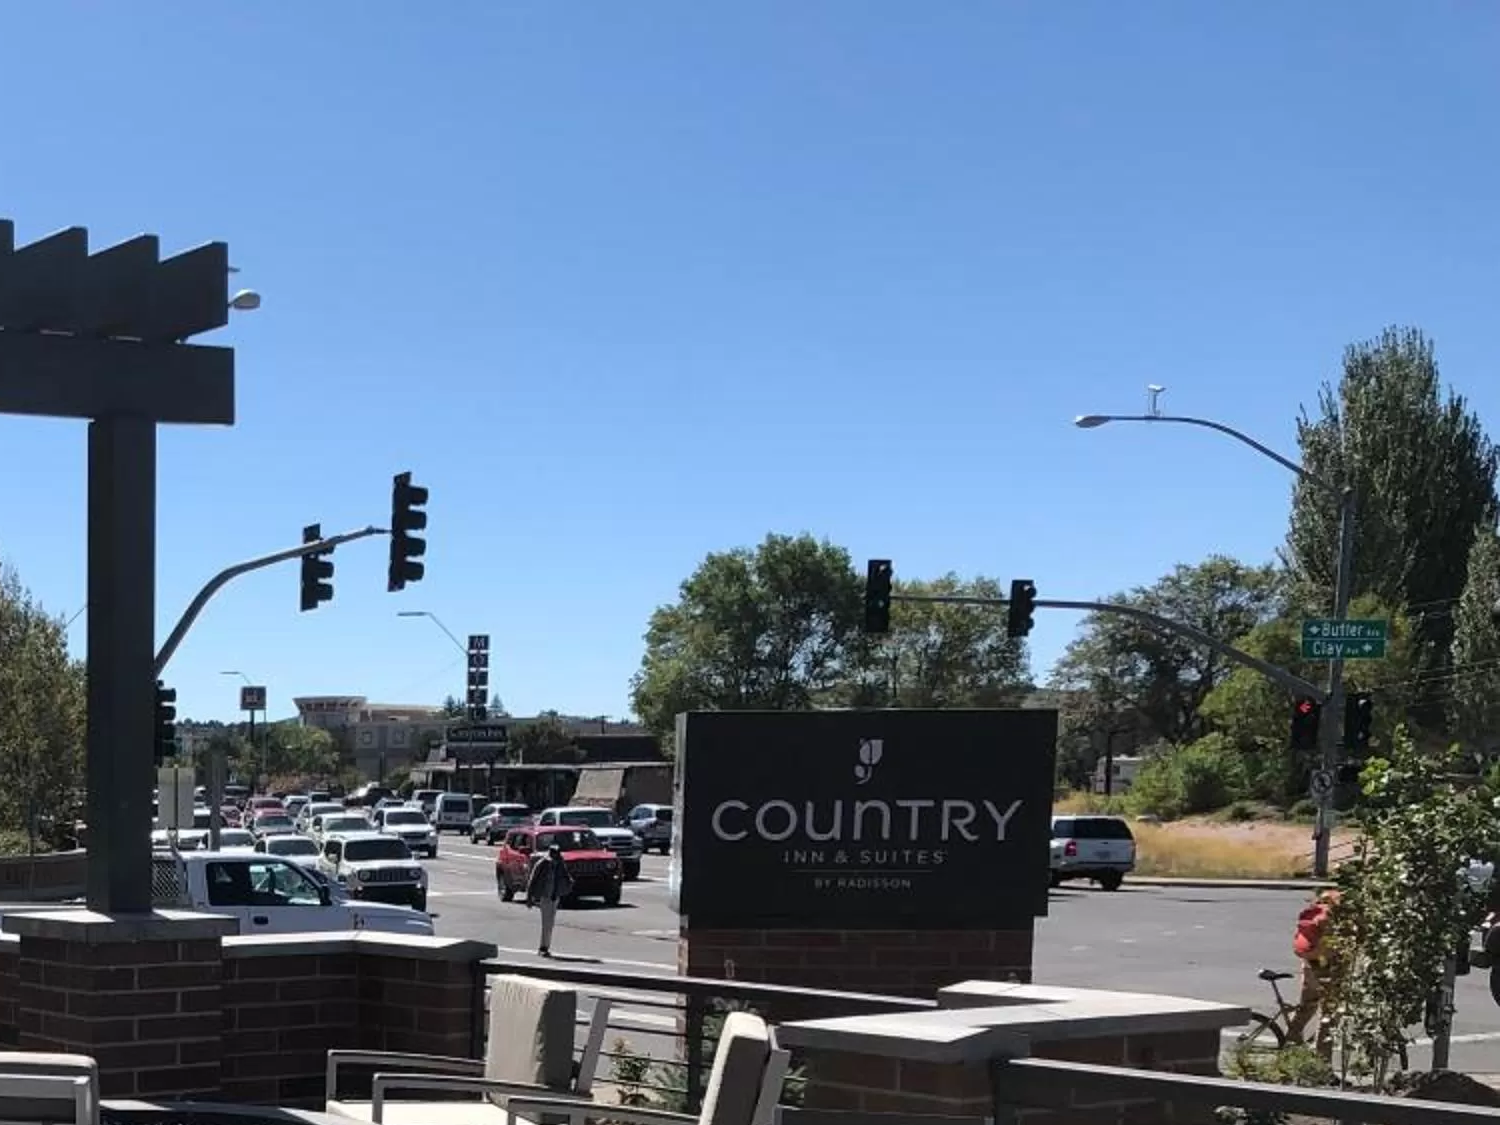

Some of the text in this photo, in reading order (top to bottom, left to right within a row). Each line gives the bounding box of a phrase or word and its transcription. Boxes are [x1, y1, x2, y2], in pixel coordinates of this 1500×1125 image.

[1321, 621, 1364, 637] Butler
[1312, 641, 1343, 656] Clay
[711, 799, 1022, 841] COUNTRY
[783, 850, 946, 864] INN & SUITES
[814, 877, 913, 889] BY RADISSON
